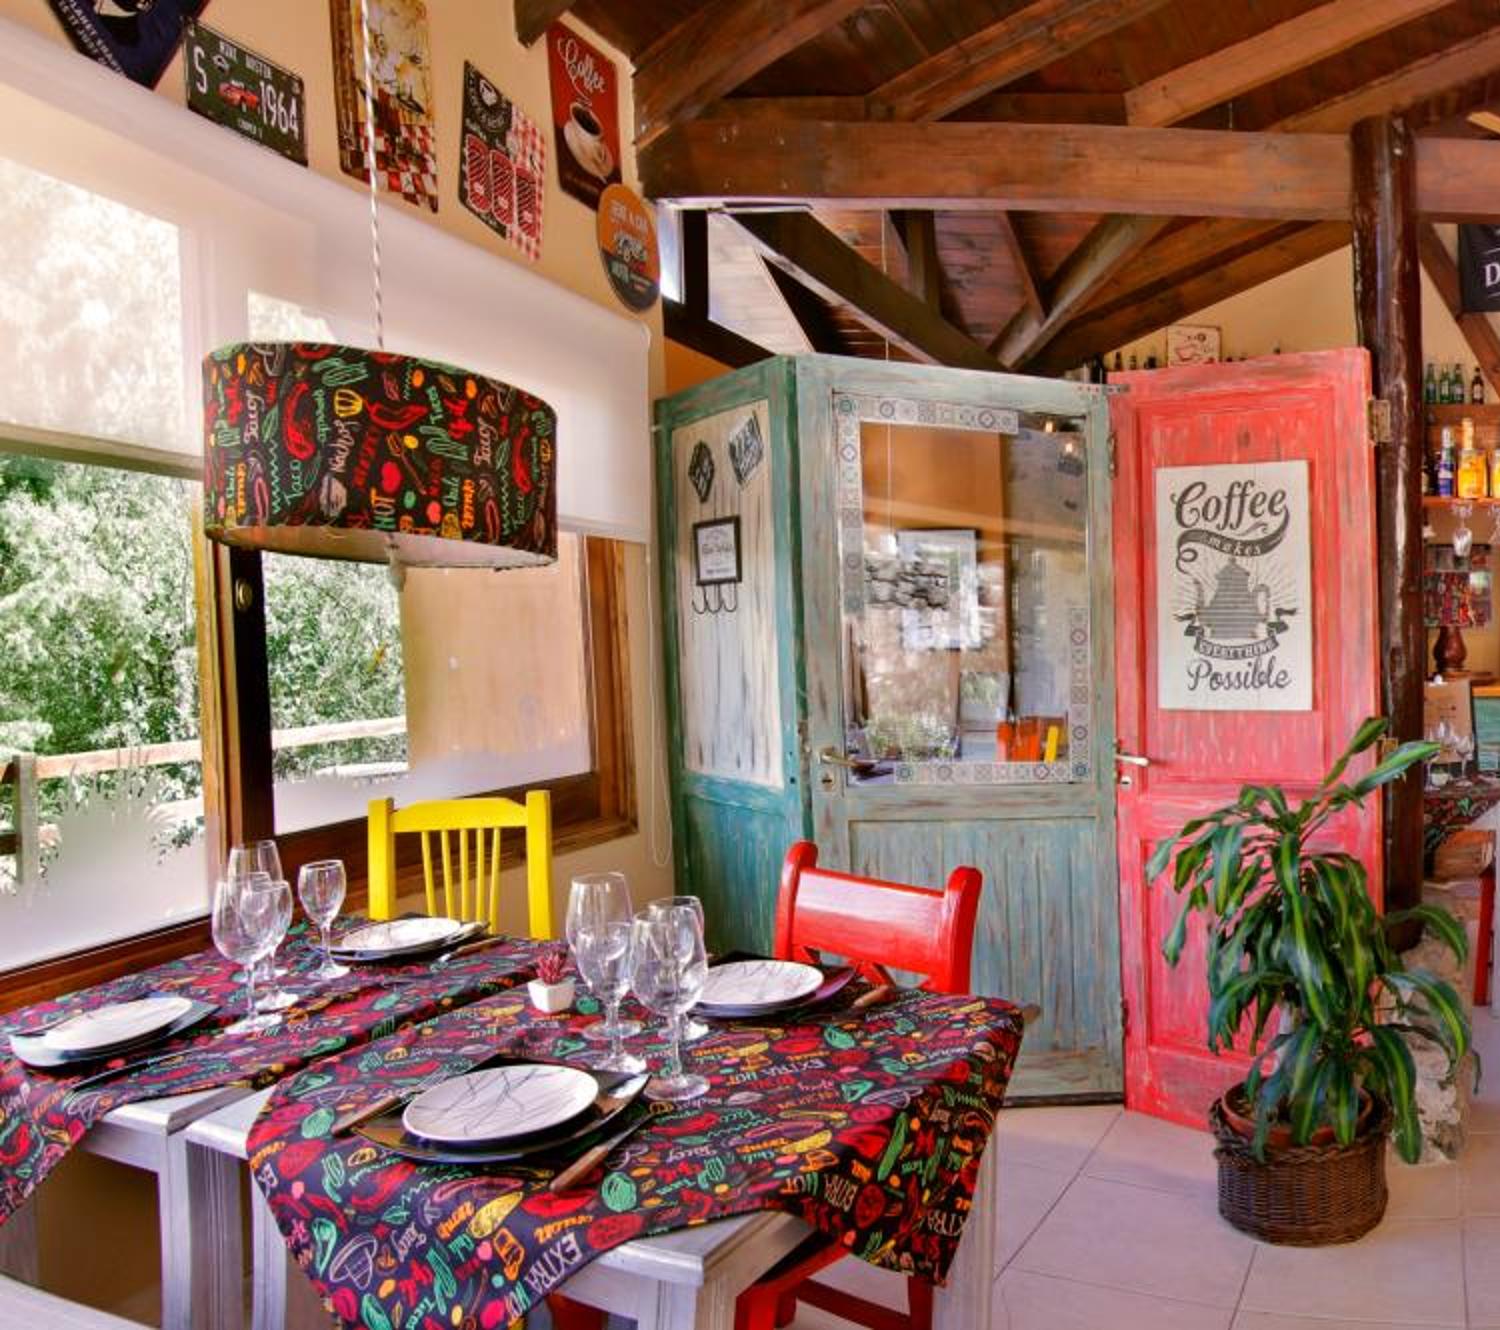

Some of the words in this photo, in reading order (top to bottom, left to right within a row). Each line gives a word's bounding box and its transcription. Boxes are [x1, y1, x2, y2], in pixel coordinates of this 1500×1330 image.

[558, 38, 606, 94] Coffee
[259, 80, 299, 140] 1964
[370, 487, 397, 530] HOT
[1170, 479, 1289, 532] Coffee
[1208, 535, 1262, 557] makes
[1187, 655, 1292, 692] Possible
[524, 1231, 584, 1295] EXTRA
